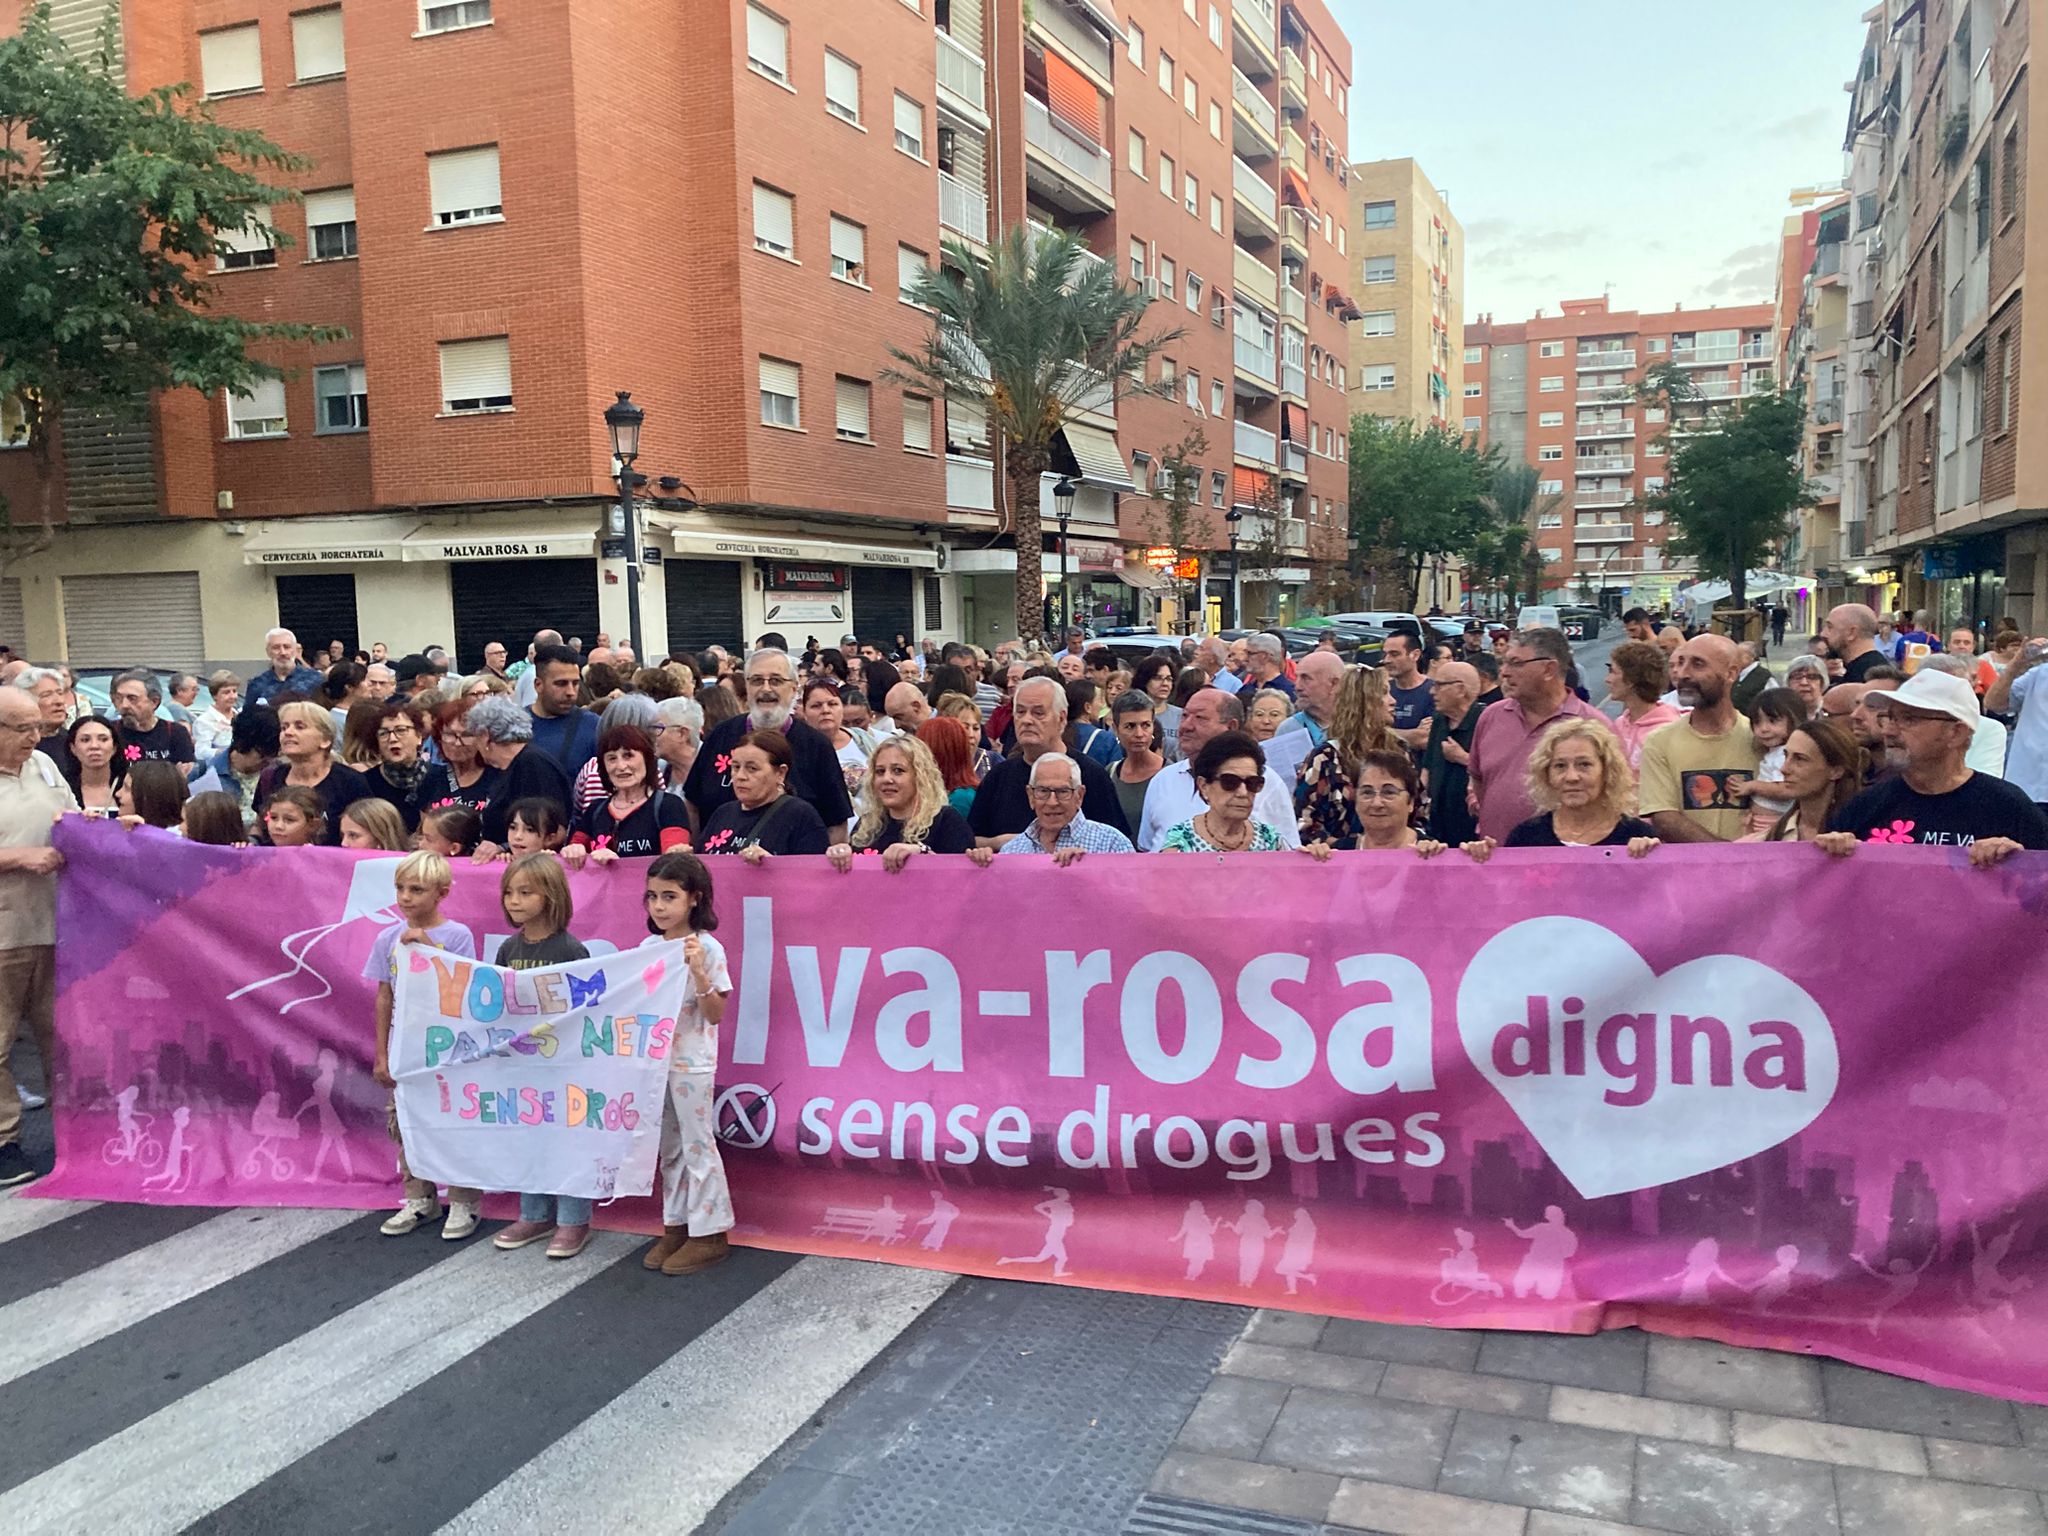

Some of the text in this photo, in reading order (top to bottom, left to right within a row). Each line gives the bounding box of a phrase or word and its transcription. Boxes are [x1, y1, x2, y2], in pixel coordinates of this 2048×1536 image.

[262, 548, 384, 562] CERVECERÍA HORCHATERÍA
[443, 544, 548, 558] MALVARROSA 18
[863, 552, 902, 563] MALVARROSA
[145, 749, 171, 760] ME VA
[617, 838, 652, 853] ME VA
[1956, 832, 1976, 847] VA
[431, 956, 607, 1023] VOLEM
[580, 1013, 675, 1061] NETS
[1491, 994, 1808, 1107] digna
[458, 1082, 555, 1126] SENSE
[799, 1083, 1446, 1181] sense drogues
